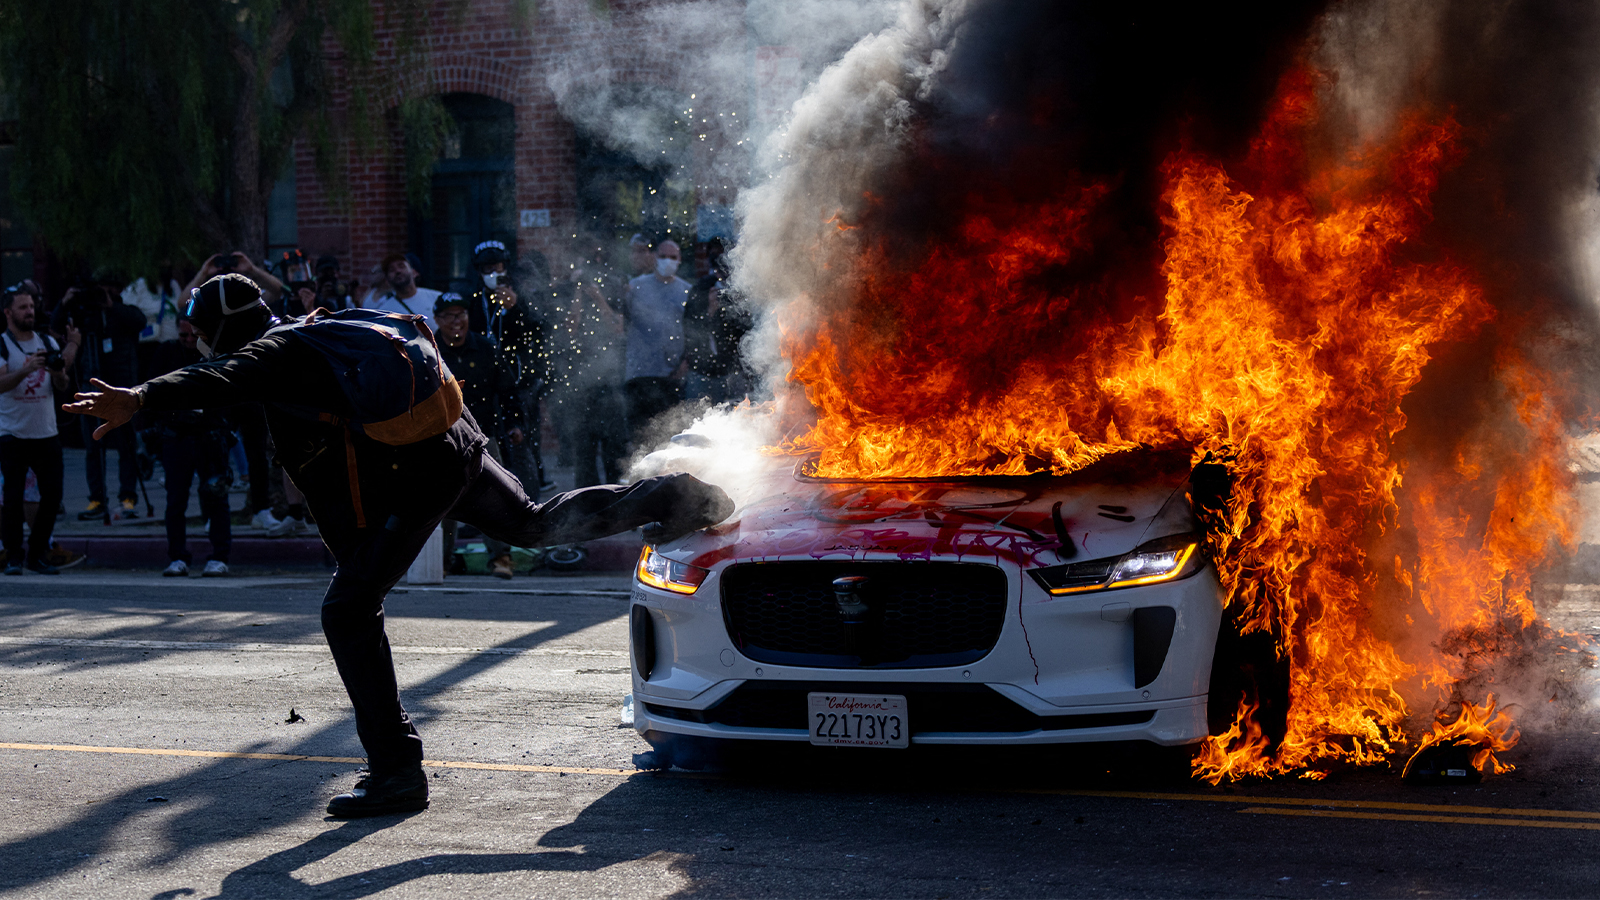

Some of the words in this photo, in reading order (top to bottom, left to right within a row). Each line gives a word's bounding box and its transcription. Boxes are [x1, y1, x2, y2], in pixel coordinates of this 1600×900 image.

[523, 212, 547, 227] 425
[474, 240, 505, 255] PRESS
[828, 696, 889, 713] California
[816, 712, 901, 740] 22173Y3
